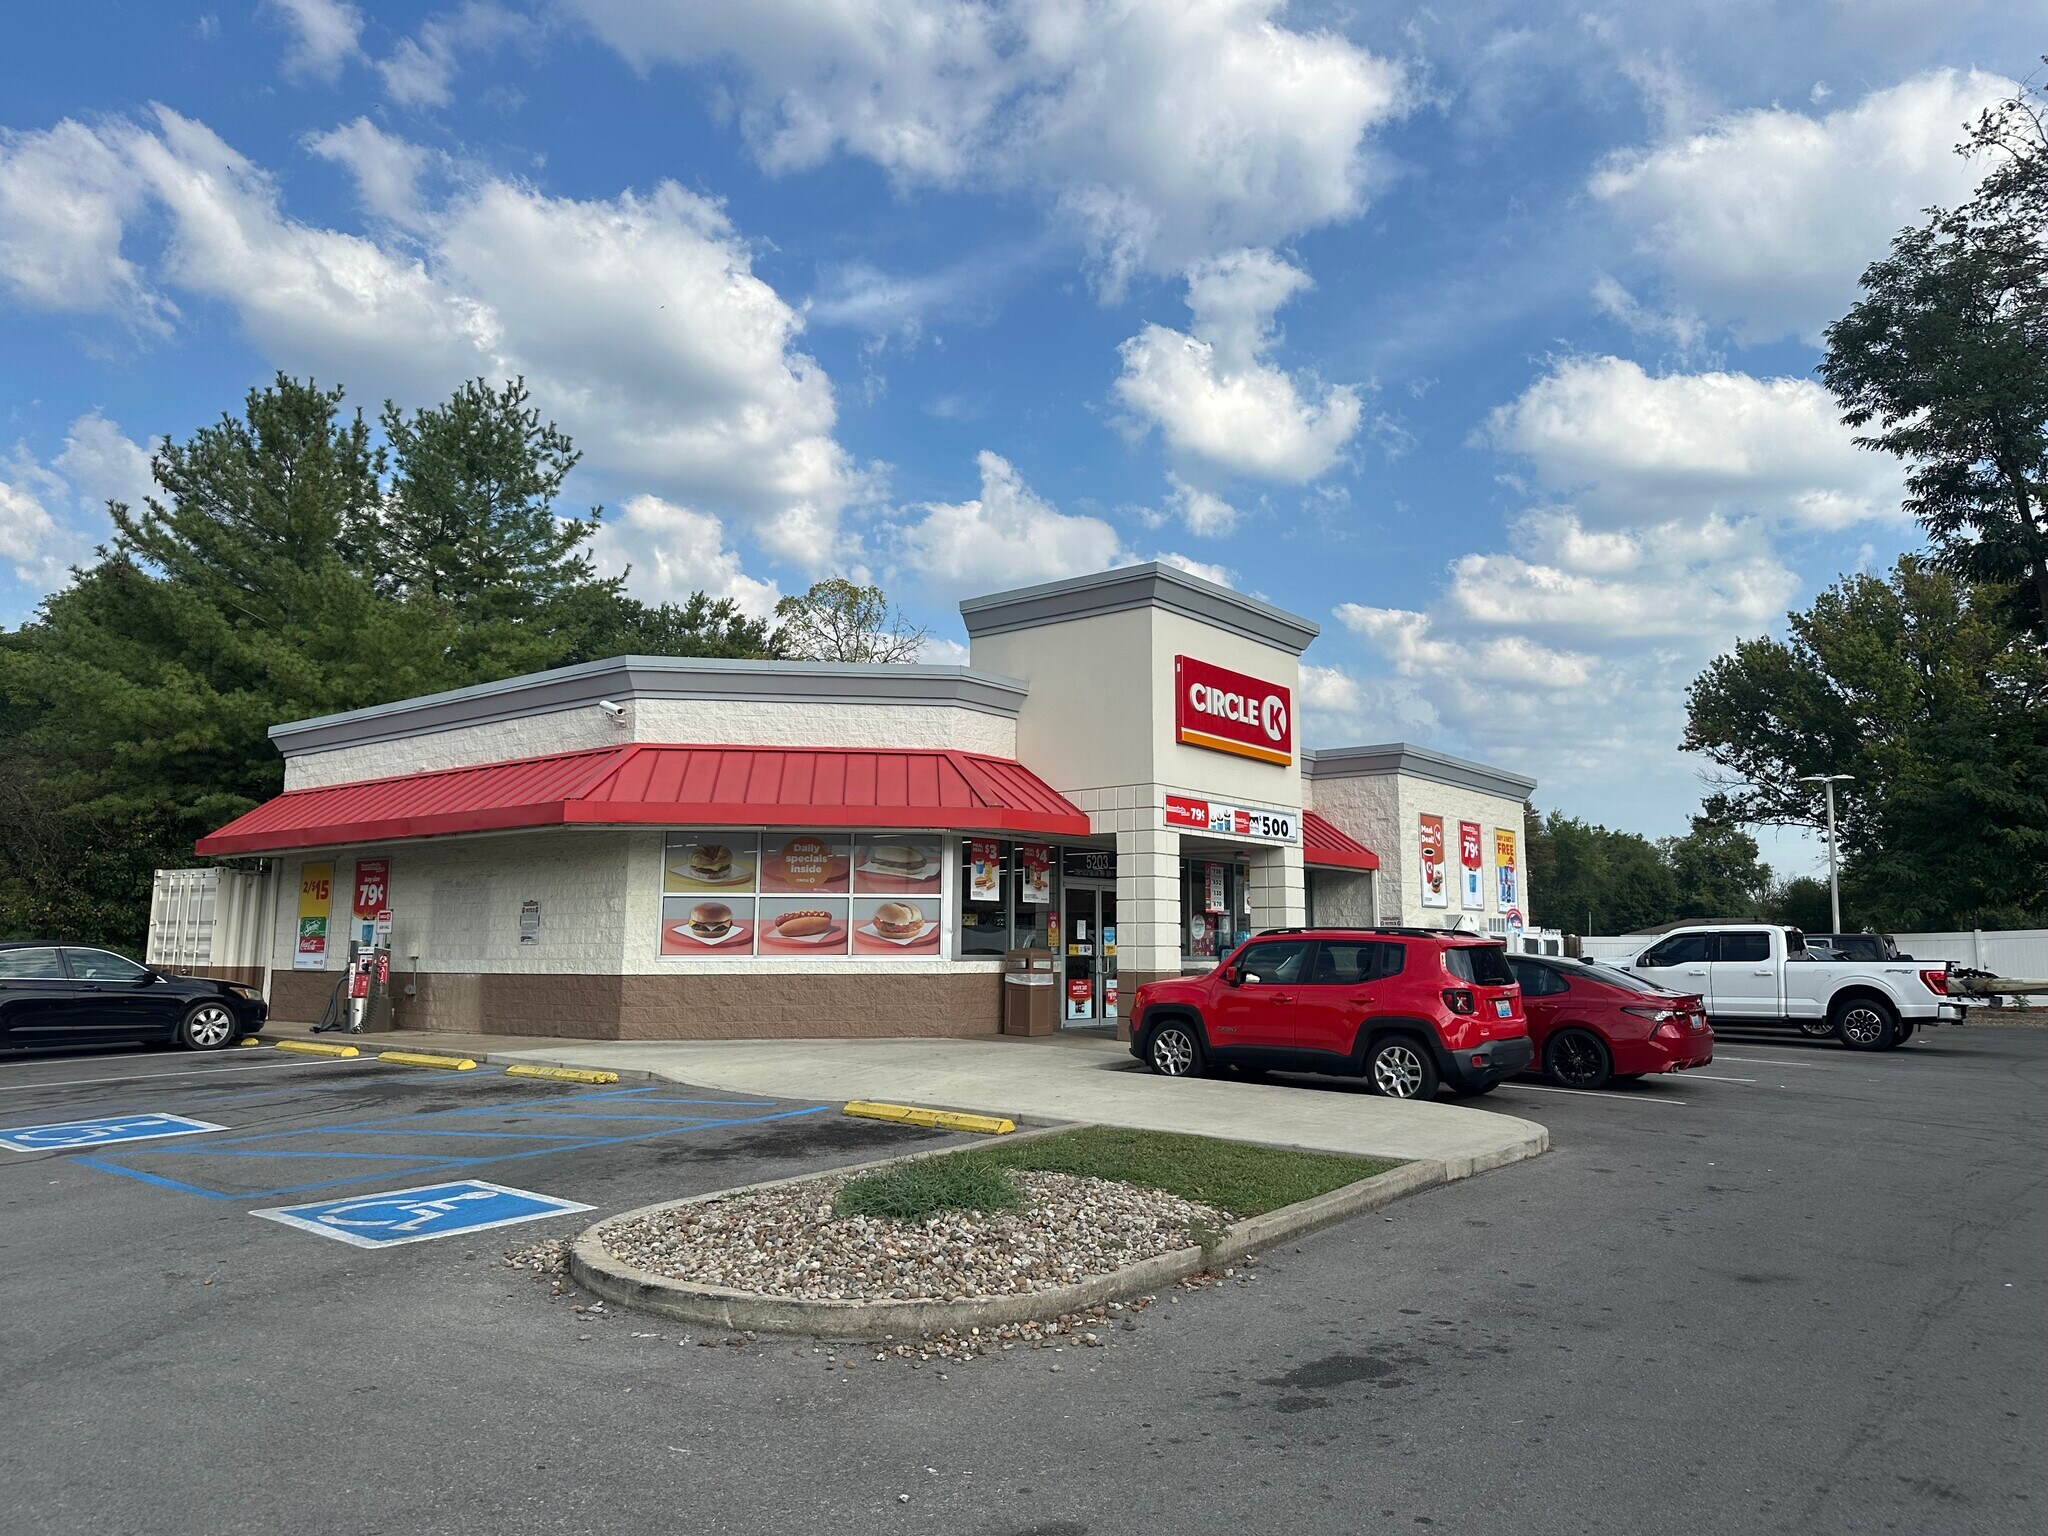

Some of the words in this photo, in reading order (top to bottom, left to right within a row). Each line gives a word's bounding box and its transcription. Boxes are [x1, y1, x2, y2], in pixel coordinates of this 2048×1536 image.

[1190, 682, 1259, 726] CIRCLE
[1264, 697, 1287, 741] K
[793, 844, 821, 853] Daily
[985, 844, 997, 859] $3
[1036, 848, 1048, 863] $4
[1463, 841, 1478, 859] 79¢
[1497, 842, 1514, 856] FREE
[785, 854, 828, 863] specials
[1086, 855, 1109, 870] 5203
[790, 865, 822, 873] inside
[303, 880, 329, 900] 2/$15
[360, 884, 384, 906] 79¢
